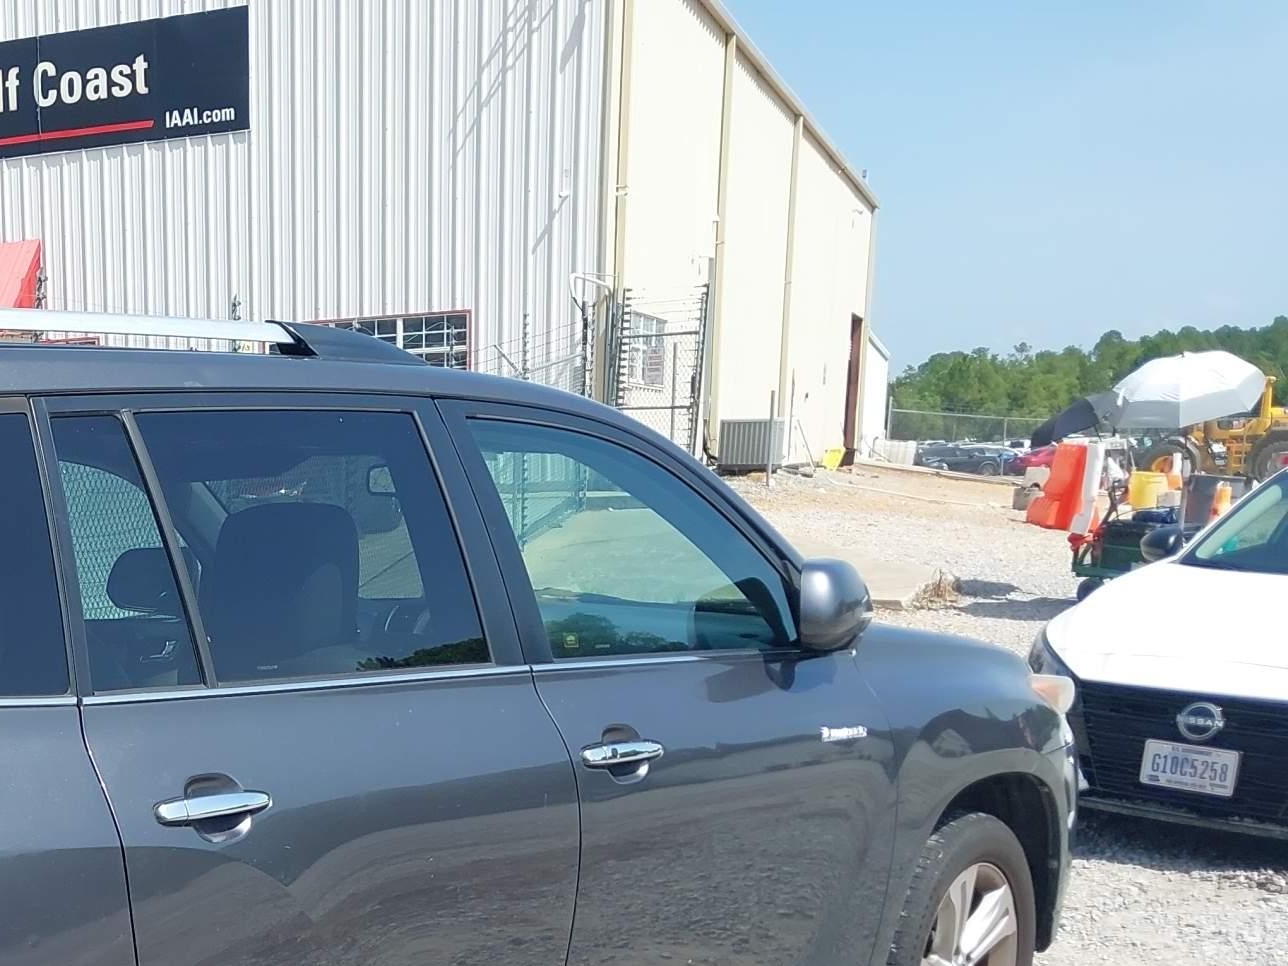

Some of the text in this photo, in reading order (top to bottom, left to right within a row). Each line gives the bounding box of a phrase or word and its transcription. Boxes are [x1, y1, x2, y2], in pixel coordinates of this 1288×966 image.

[33, 54, 149, 108] Coast
[165, 106, 235, 128] IAAI.com
[1151, 753, 1229, 783] G10C5258
